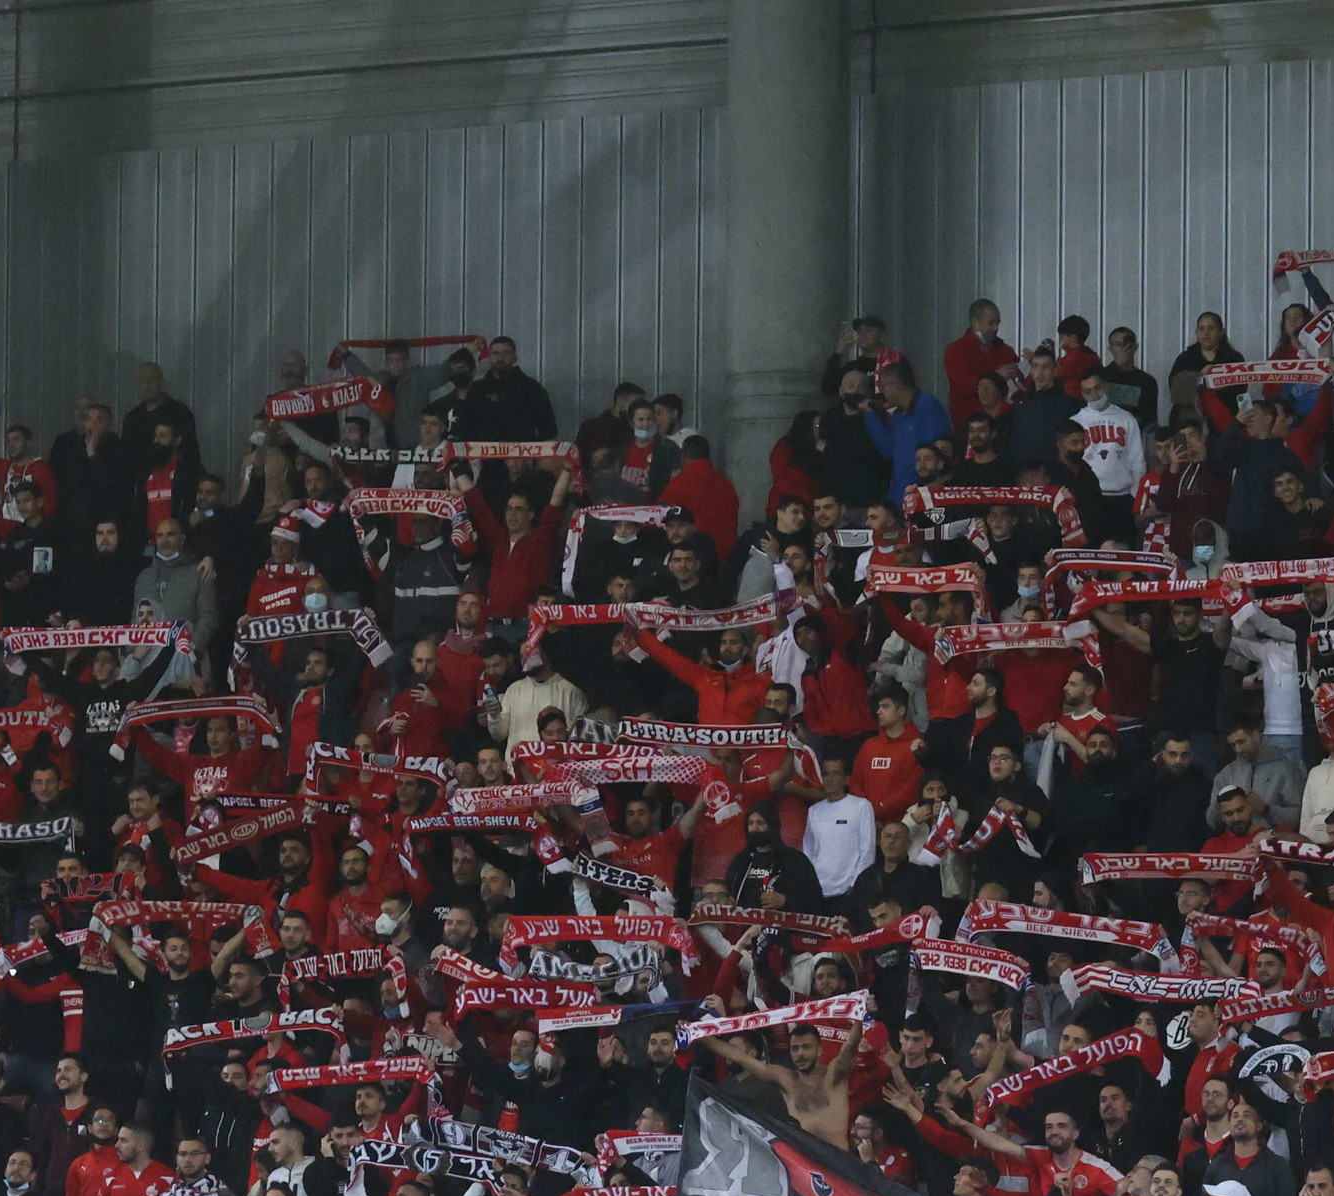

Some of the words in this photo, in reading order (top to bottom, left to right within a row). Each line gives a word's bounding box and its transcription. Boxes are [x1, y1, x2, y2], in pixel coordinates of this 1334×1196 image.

[911, 570, 947, 586] באר
[1167, 580, 1208, 592] הפועל
[258, 808, 295, 829] הפועל
[411, 821, 451, 832] HAPOEL
[454, 817, 521, 829] BEER-SHEVA
[208, 834, 229, 851] באר
[1094, 857, 1140, 873] שבע
[1156, 857, 1191, 872] באר
[1198, 856, 1256, 873] הפועל
[974, 899, 1053, 921] שבע
[525, 920, 561, 938] שבע
[567, 920, 605, 937] באר
[617, 918, 664, 938] הפועל
[1077, 909, 1151, 934] באר
[1026, 922, 1053, 934] BEER
[1060, 928, 1097, 940] SHEVA
[455, 986, 548, 1013] באר-שבע
[1078, 1031, 1143, 1066] הפועל
[281, 1067, 320, 1083] שבע
[328, 1063, 367, 1078] באר
